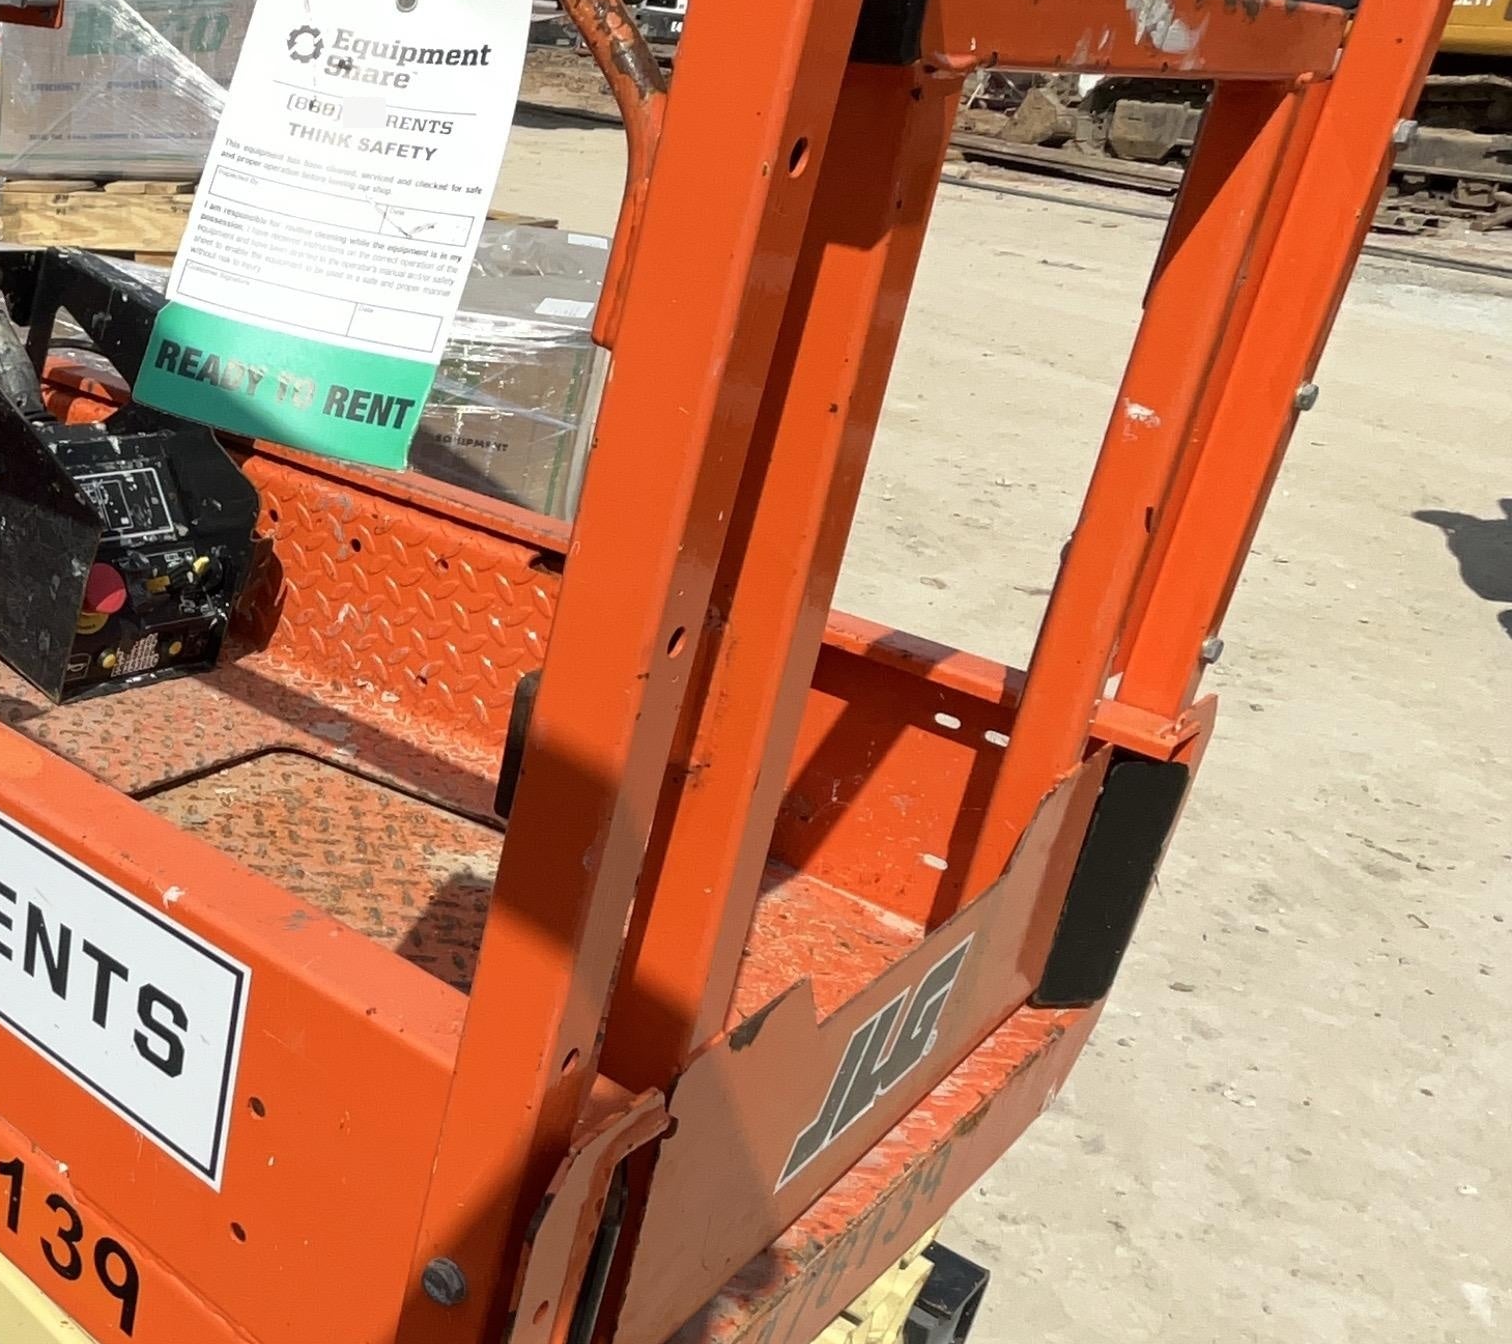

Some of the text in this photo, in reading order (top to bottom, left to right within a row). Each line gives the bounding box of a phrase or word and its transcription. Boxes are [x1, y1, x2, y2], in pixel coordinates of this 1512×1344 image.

[331, 27, 493, 67] Equipment
[323, 54, 411, 90] Share
[221, 150, 237, 160] and
[236, 155, 262, 168] proper
[288, 121, 438, 162] THINK SAFETY
[243, 145, 285, 160] equipment
[397, 177, 412, 186] and
[415, 179, 449, 191] checked
[451, 184, 463, 193] for
[465, 185, 483, 195] safe
[190, 246, 217, 260] without
[209, 203, 222, 212] am
[223, 207, 268, 226] responsible
[372, 240, 385, 250] the
[387, 245, 430, 258] equipment
[431, 249, 438, 259] is
[440, 251, 448, 260] in
[450, 253, 463, 264] my
[236, 235, 250, 245] and
[432, 276, 455, 287] safety
[400, 258, 435, 271] operation
[436, 263, 446, 272] of
[446, 264, 459, 275] the
[395, 283, 420, 293] proper
[422, 286, 452, 298] manner
[153, 338, 417, 431] READY TO RENT
[772, 930, 976, 1197] JLG
